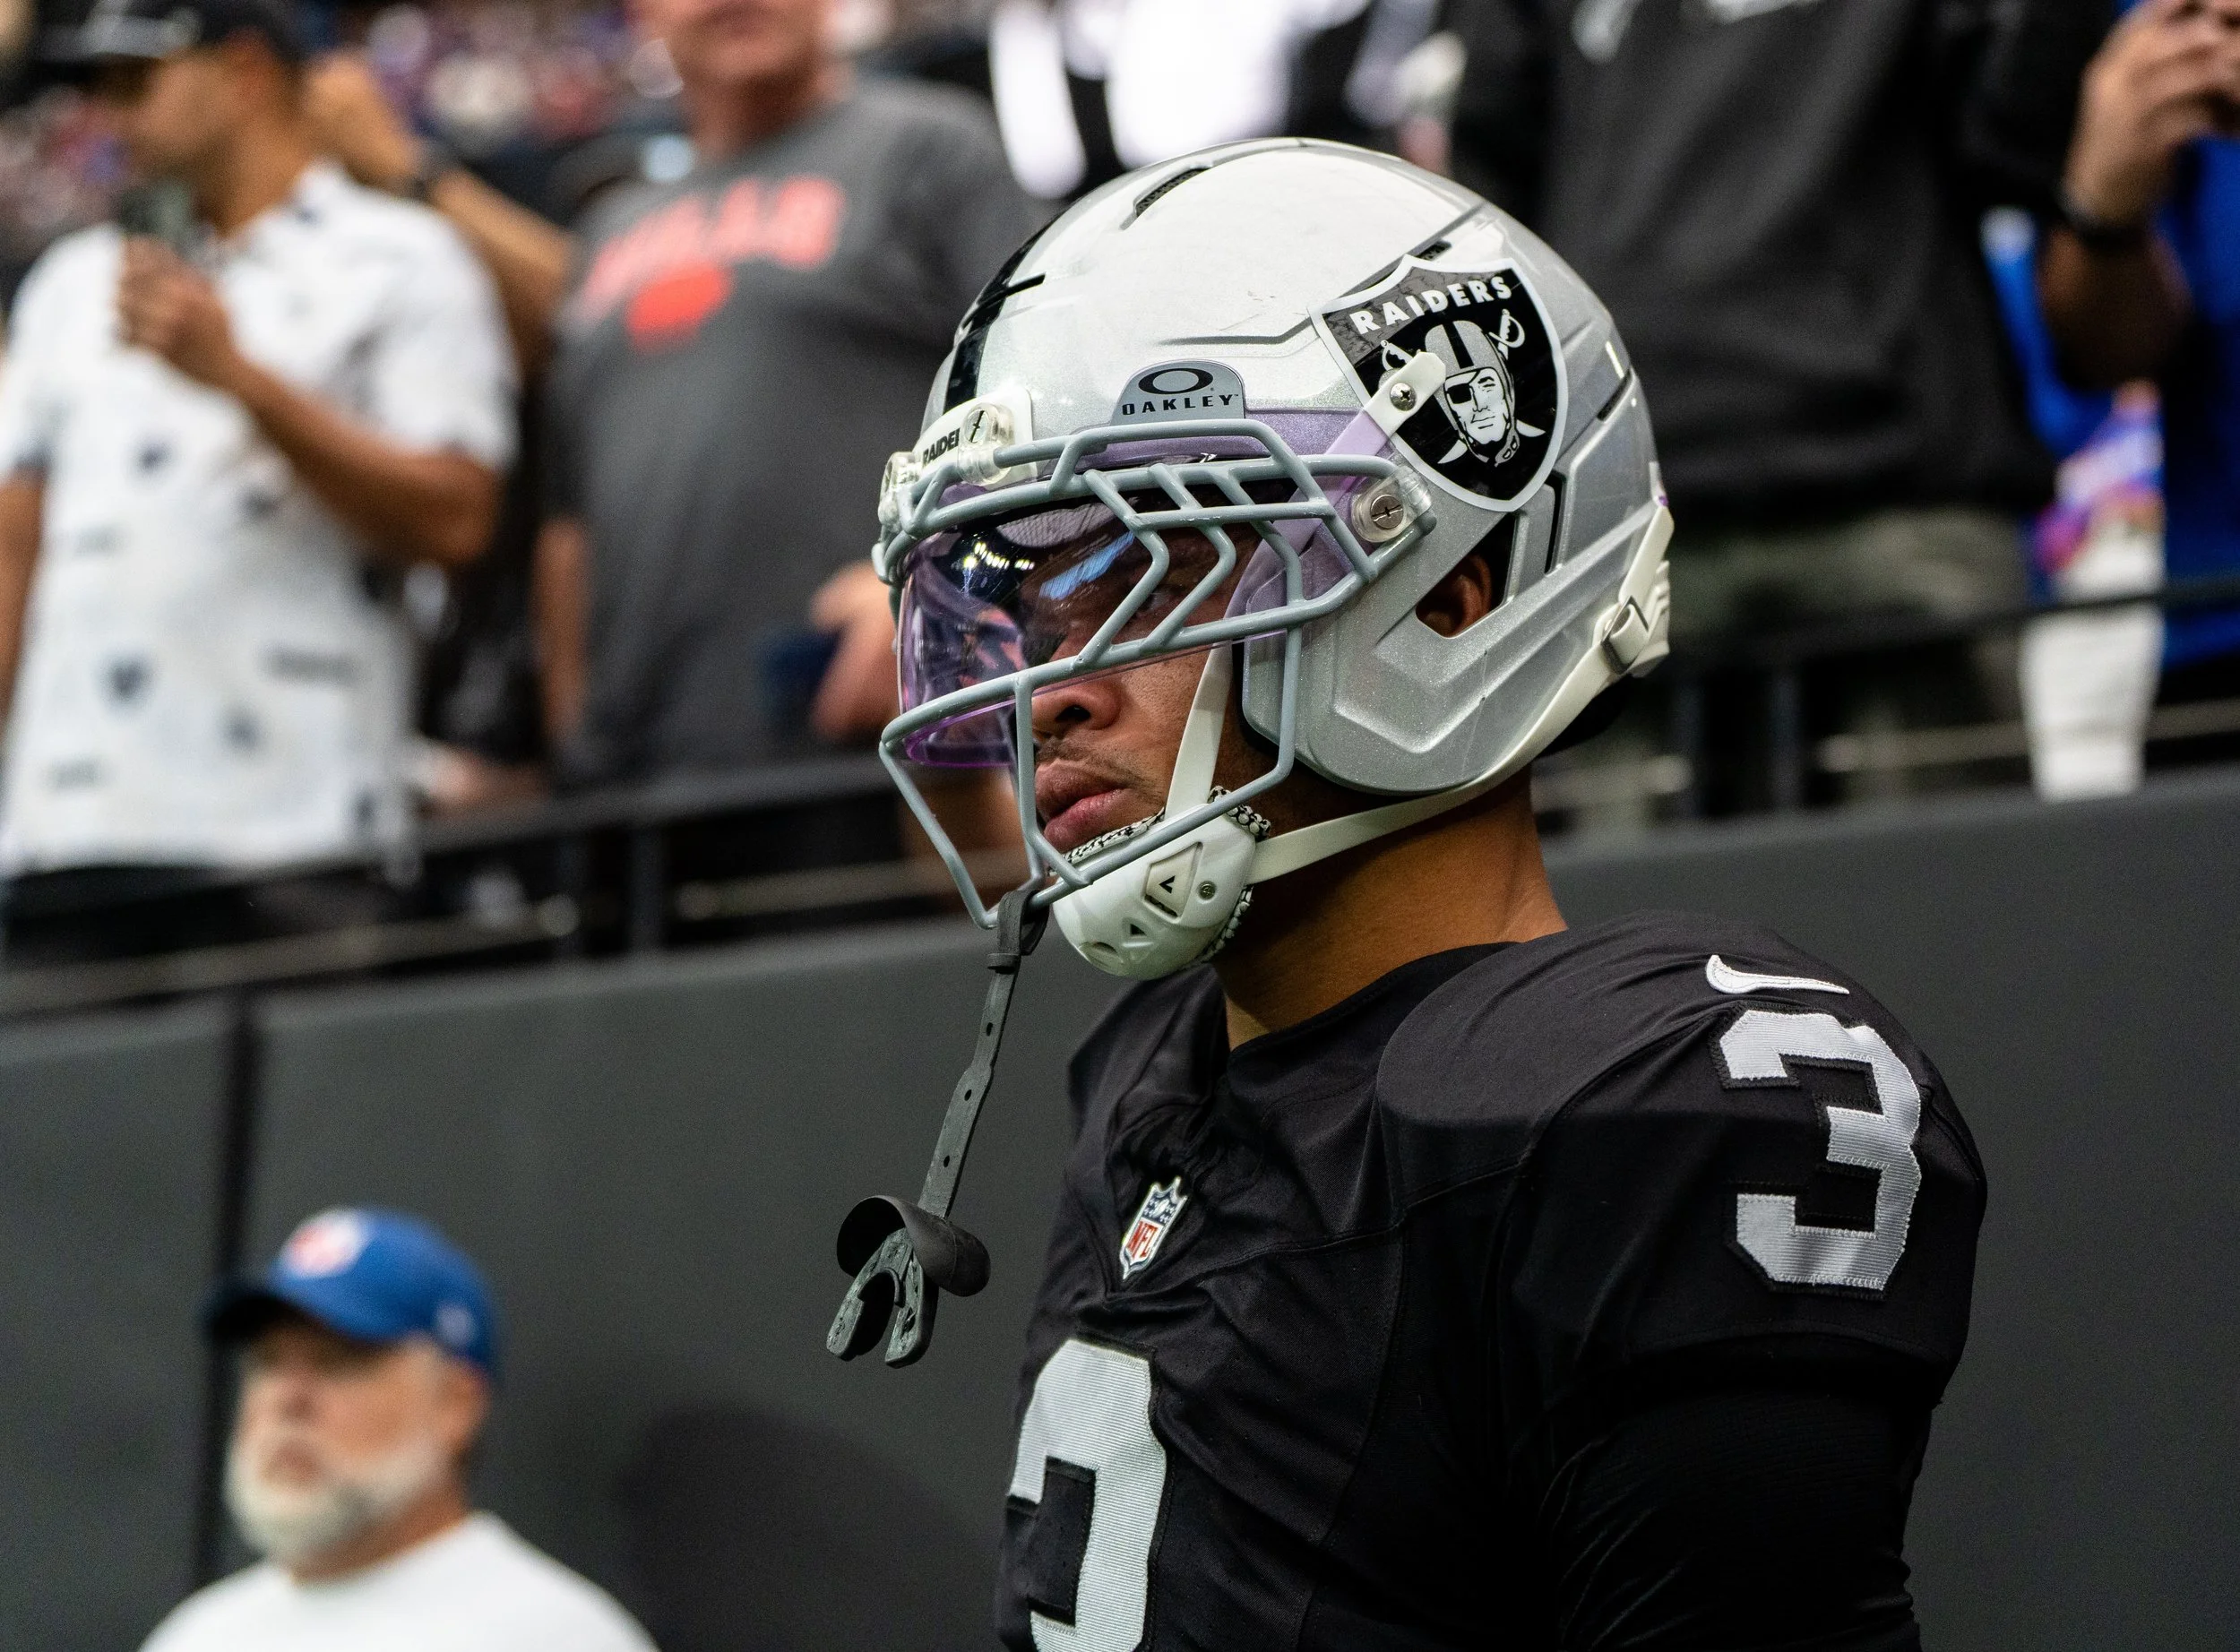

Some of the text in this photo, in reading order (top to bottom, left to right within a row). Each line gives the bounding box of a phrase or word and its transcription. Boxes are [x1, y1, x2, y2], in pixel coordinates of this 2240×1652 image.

[1349, 275, 1512, 335] RAIDERS
[1122, 394, 1234, 416] OAKLEY
[1719, 1009, 1922, 1291] 3
[1125, 1220, 1159, 1260] NFL
